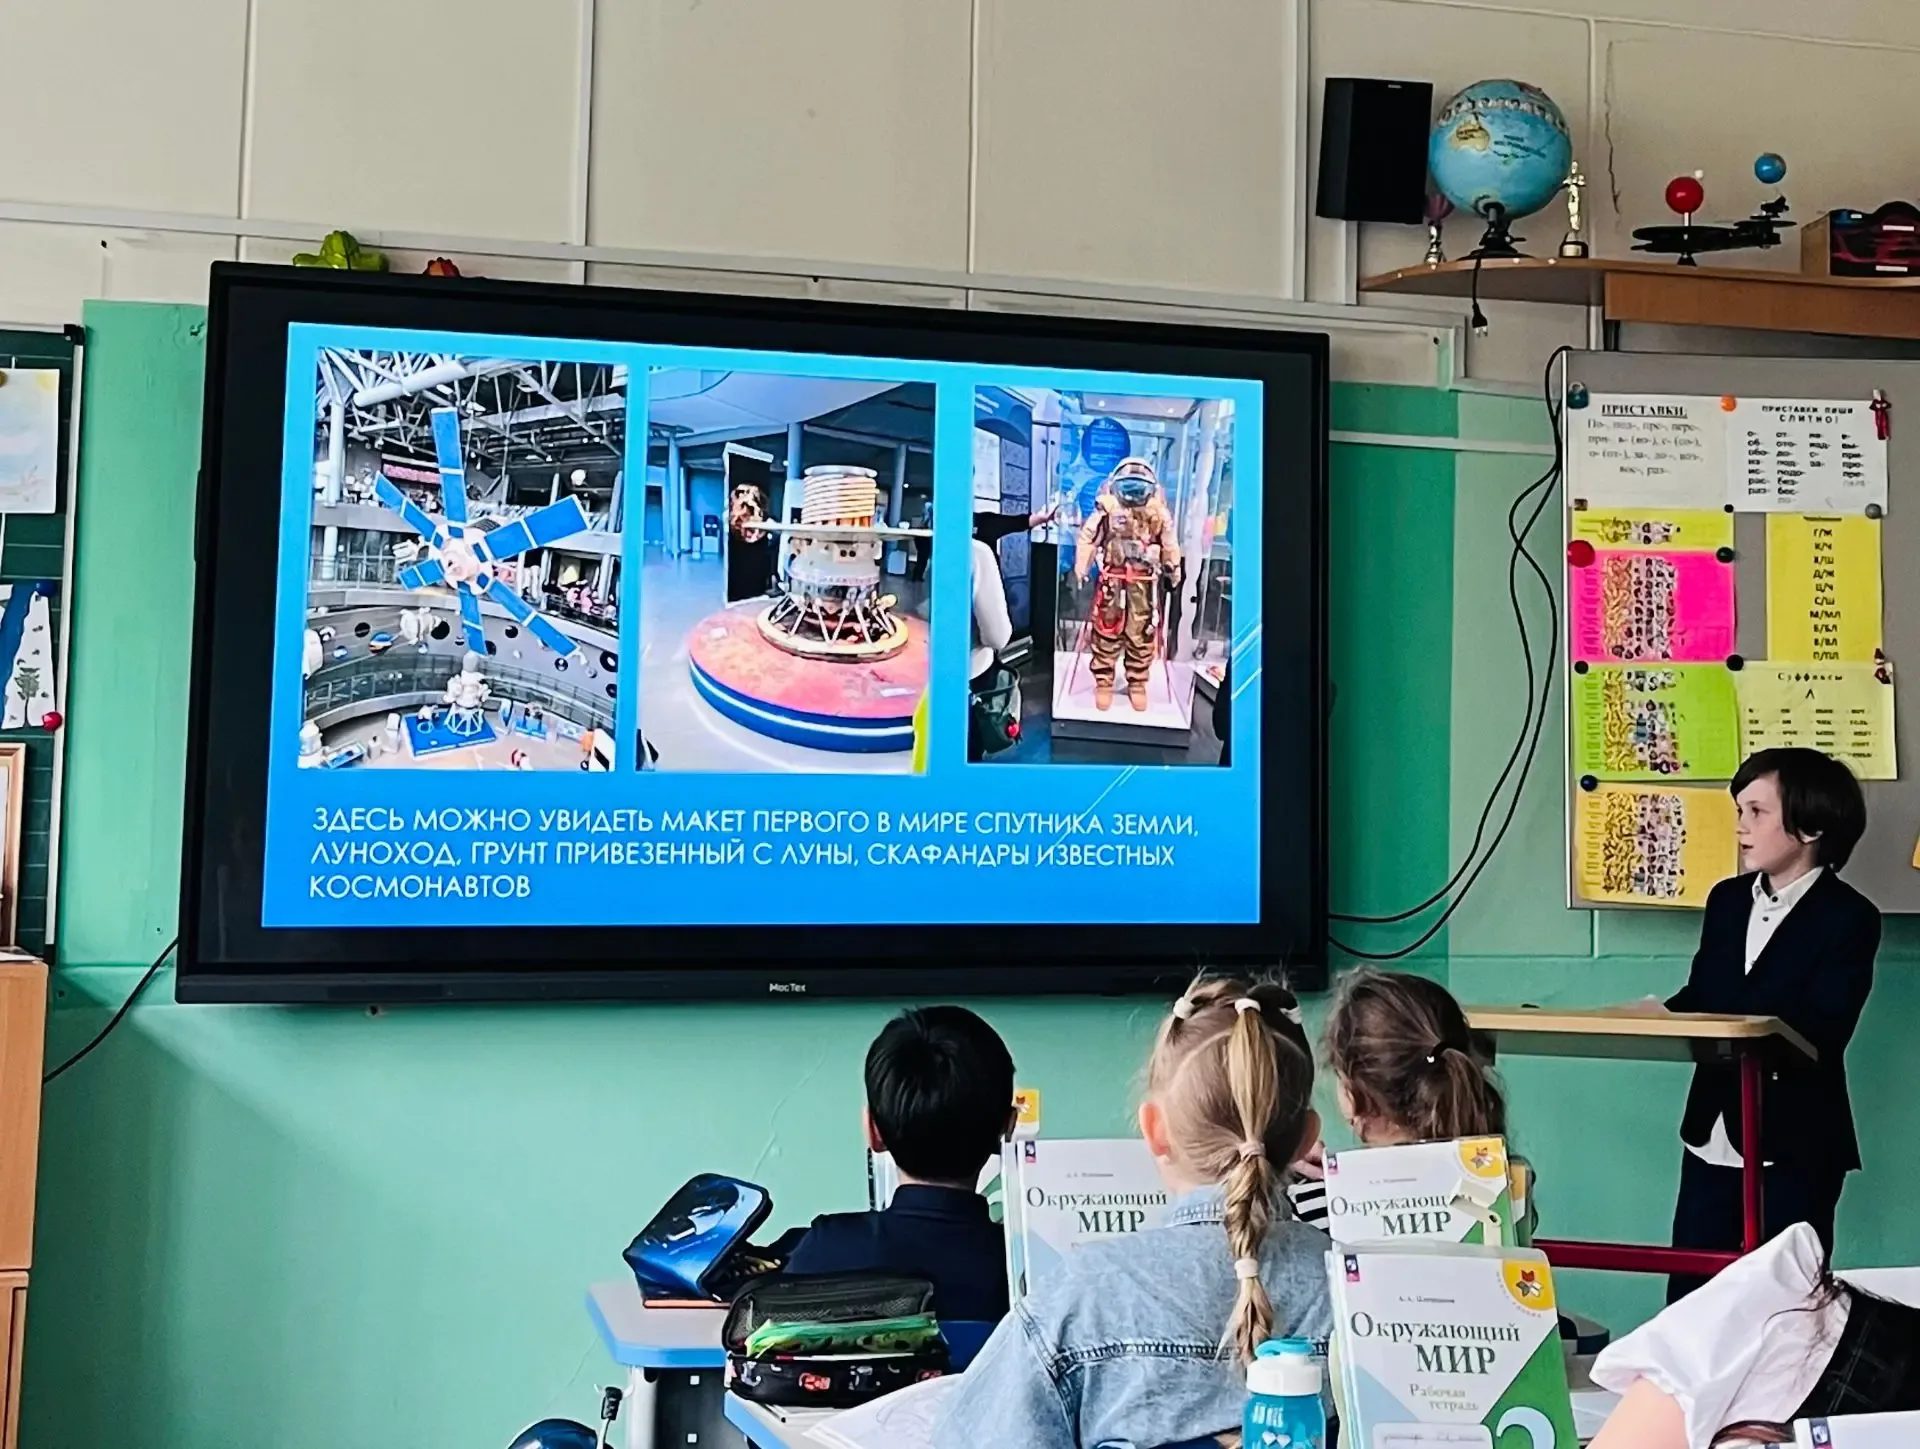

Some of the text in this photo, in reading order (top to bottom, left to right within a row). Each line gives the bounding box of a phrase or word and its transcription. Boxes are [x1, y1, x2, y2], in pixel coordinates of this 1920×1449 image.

[1762, 405, 1818, 413] ПРИСТАВКИ
[1779, 414, 1838, 424] СЛИТНО!
[312, 807, 1199, 837] ЗДЕСЬ МОЖНО УВИДЕТЬ МАКЕТ ПЕРВОГО В МИРЕ СПУТНИКА ЗЕМЛИ,
[310, 838, 1175, 868] ЛУНОХОД, ГРУНТ ПРИВЕЗЕННЫЙ С ЛУНЫ, СКАФАНДРЫ ИЗВЕСТНЫХ
[309, 874, 532, 899] КОСМОНАВТОВ
[1026, 1186, 1168, 1210] Окружающий
[1330, 1194, 1473, 1217] Окружающ
[1078, 1210, 1146, 1233] МИР
[1383, 1211, 1452, 1237] МИР
[1350, 1311, 1521, 1343] Окружающий
[1415, 1343, 1496, 1375] МИР
[1410, 1383, 1466, 1399] Рабочая
[1429, 1400, 1479, 1412] тетрадь
